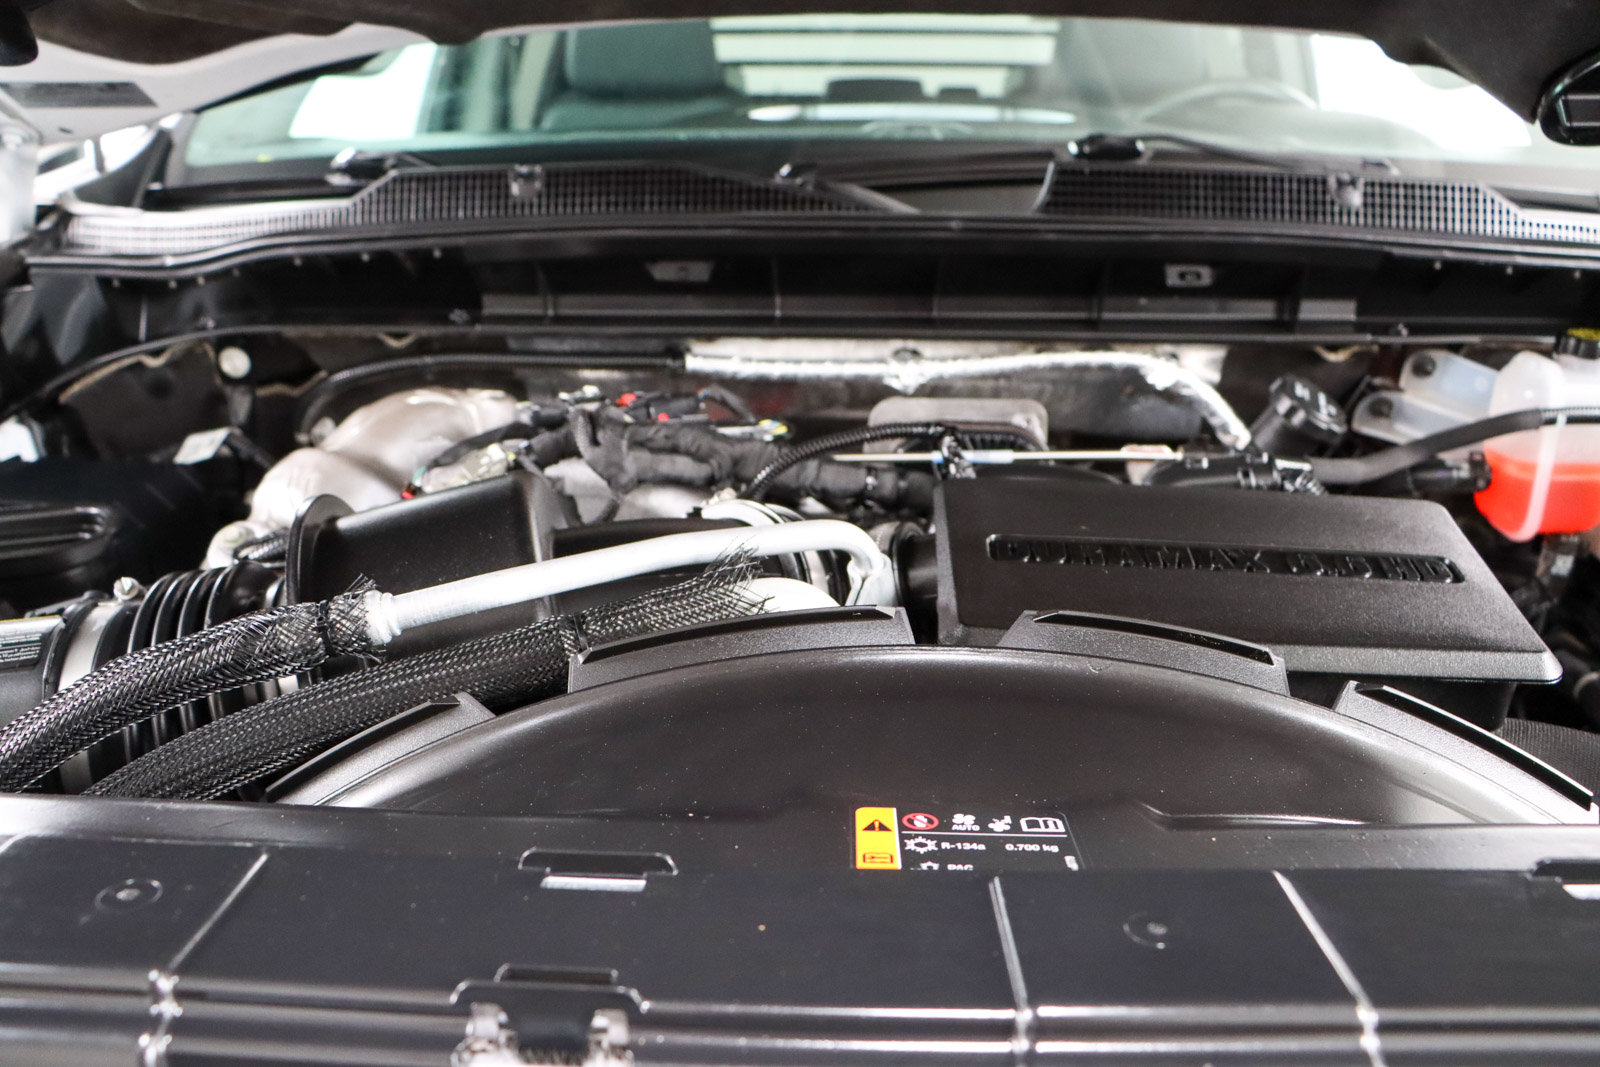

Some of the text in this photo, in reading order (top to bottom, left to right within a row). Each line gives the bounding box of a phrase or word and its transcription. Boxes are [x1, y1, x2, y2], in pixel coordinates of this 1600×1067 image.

[940, 842, 1059, 853] R-134a 0.700 kg
